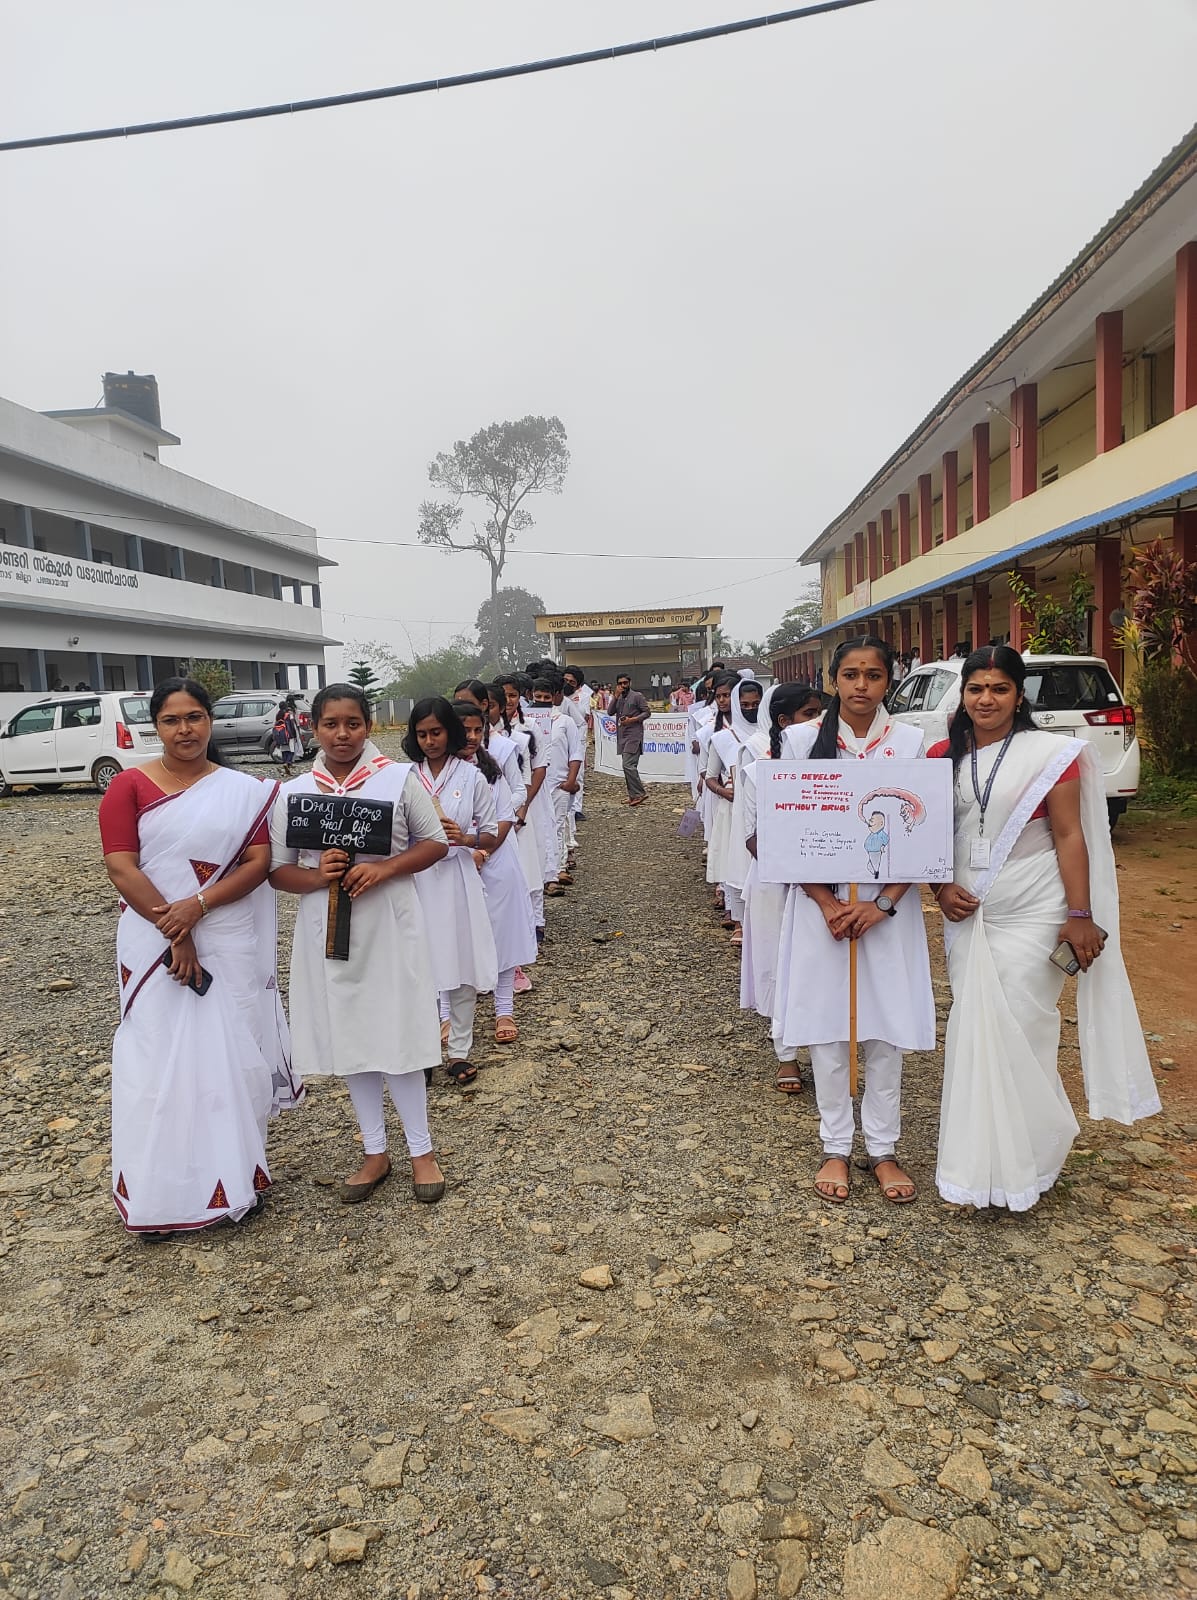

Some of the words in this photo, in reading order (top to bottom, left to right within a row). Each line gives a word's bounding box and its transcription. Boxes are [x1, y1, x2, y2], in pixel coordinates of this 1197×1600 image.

[773, 773, 797, 781] LET'S
[801, 773, 843, 781] DEVELOP
[775, 803, 818, 811] WITHOUT
[291, 815, 310, 828] are
[319, 818, 344, 831] real
[352, 820, 372, 837] life
